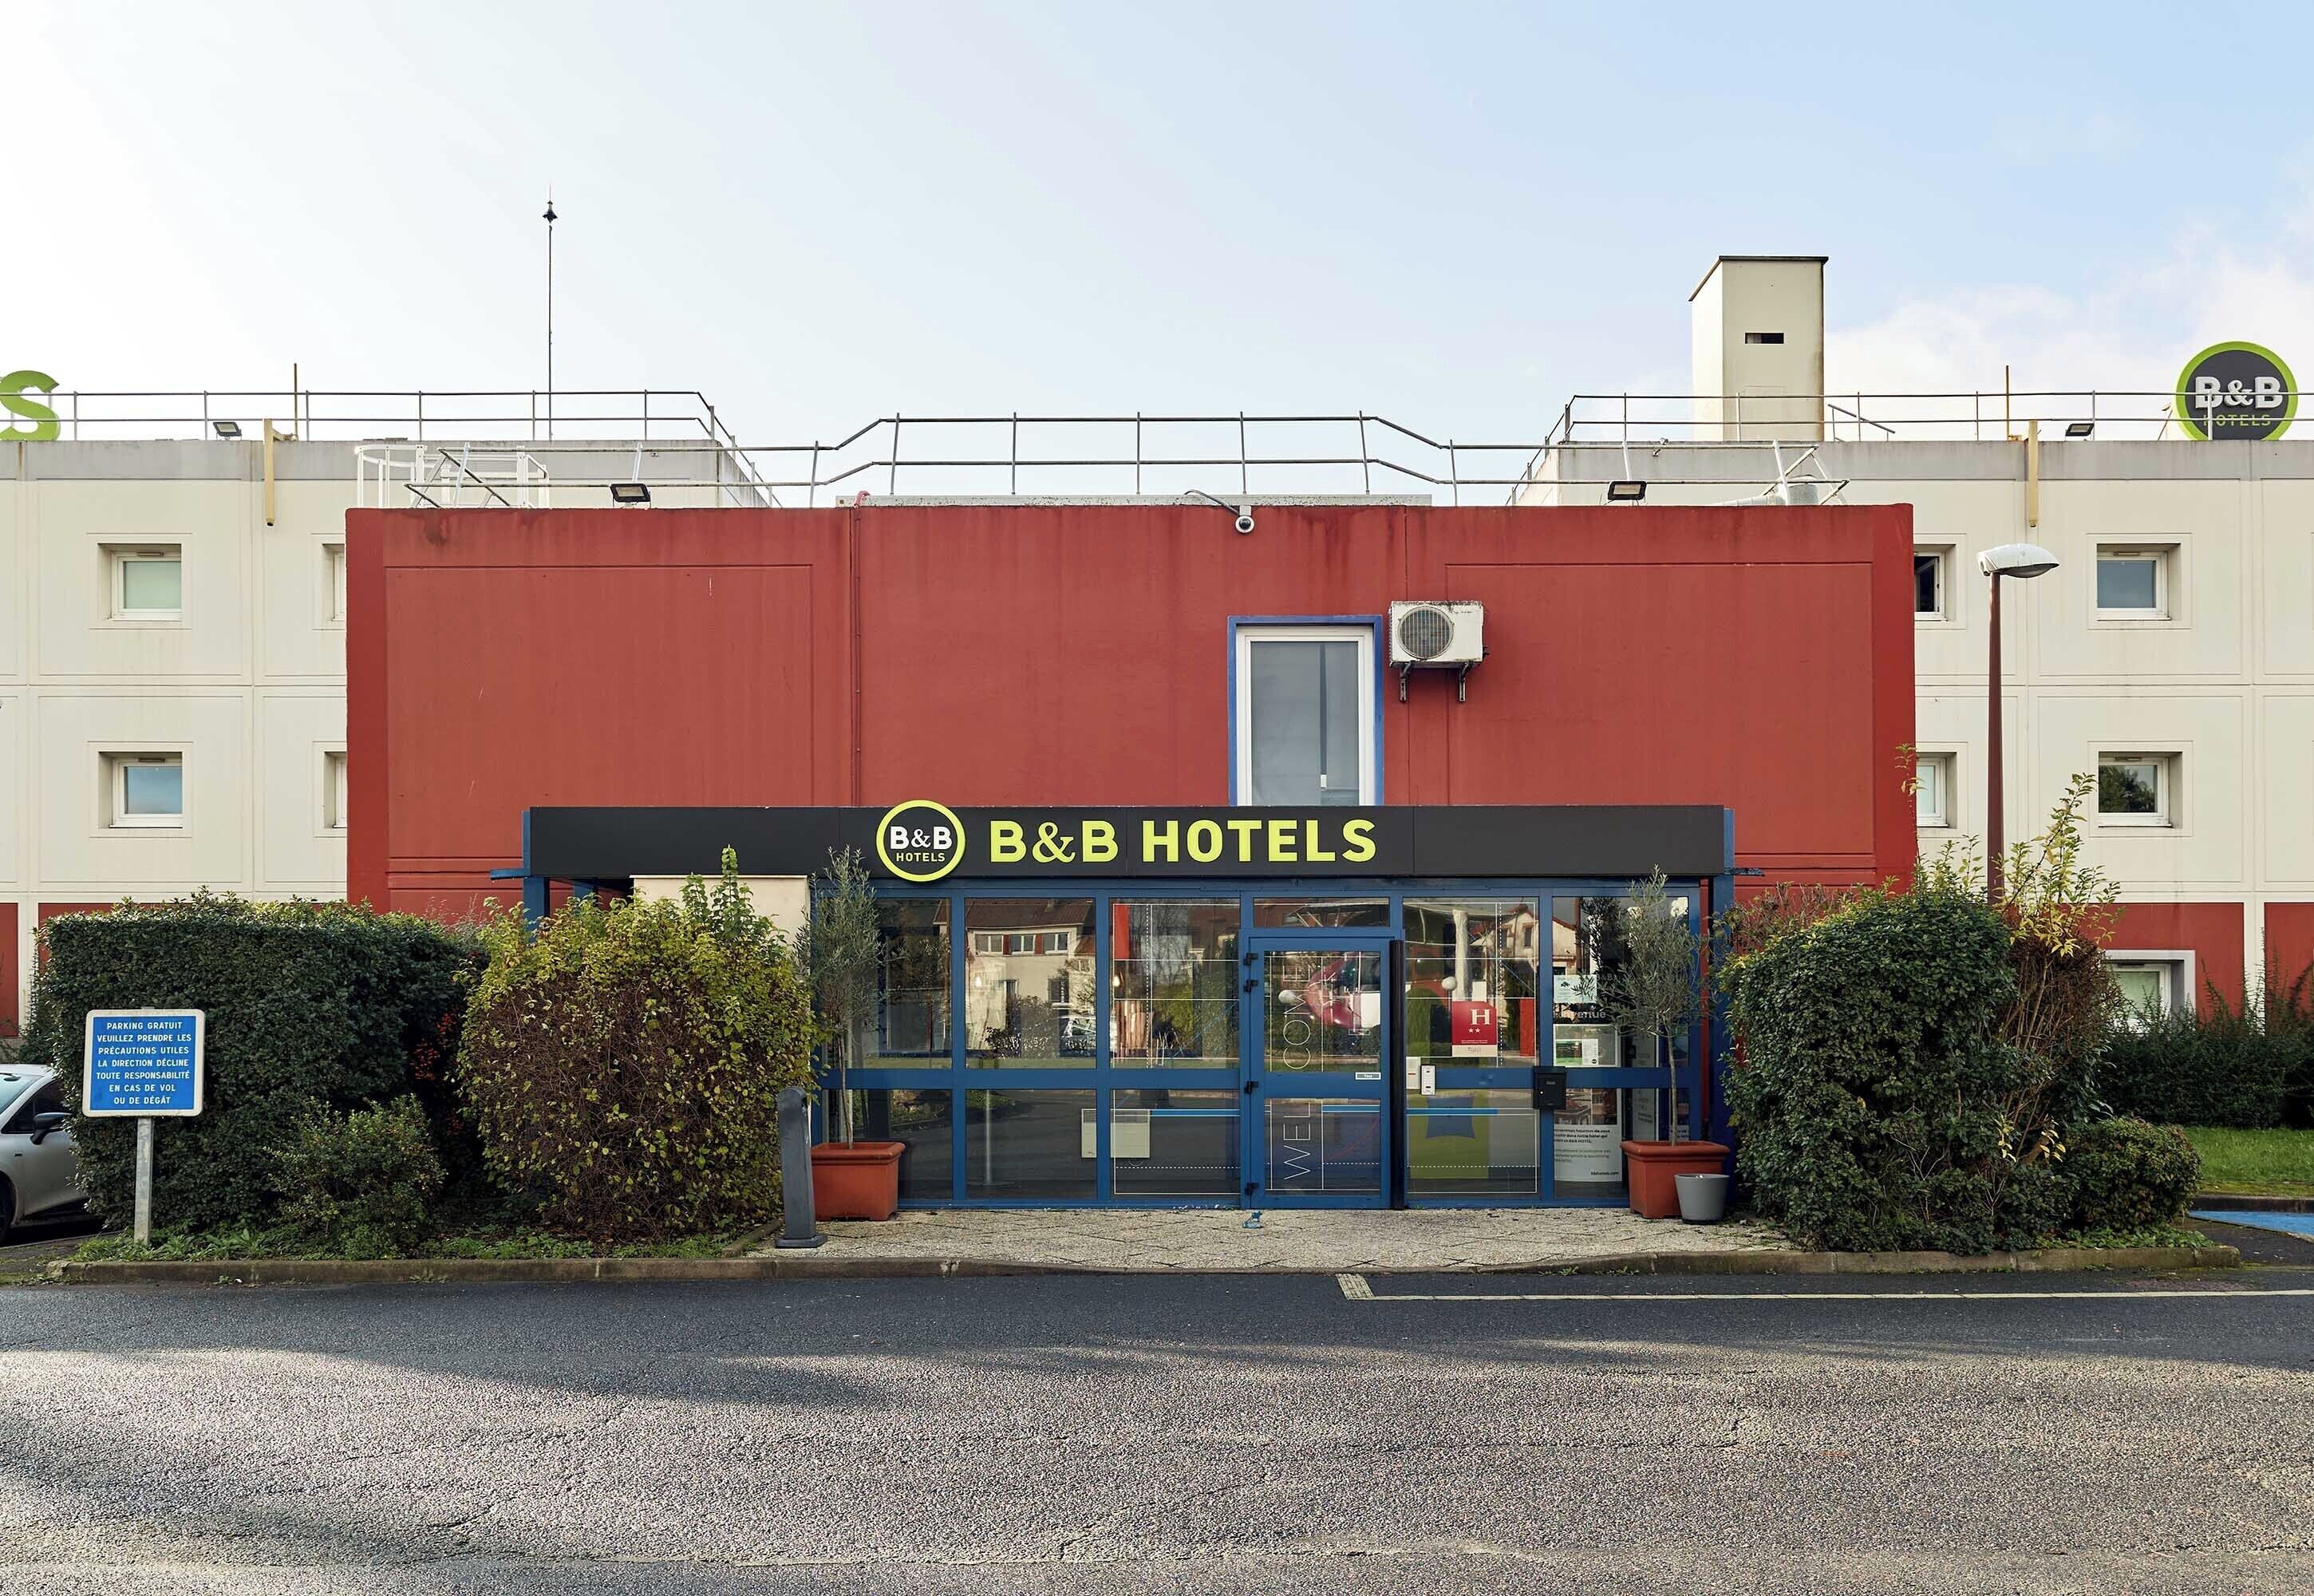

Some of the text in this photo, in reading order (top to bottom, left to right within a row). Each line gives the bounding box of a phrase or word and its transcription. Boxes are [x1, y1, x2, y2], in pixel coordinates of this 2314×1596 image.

[2195, 376, 2284, 409] B&B
[890, 826, 953, 850] B&B
[990, 819, 1376, 863] B&B HOTELS
[896, 852, 946, 862] HOTELS
[1470, 1009, 1491, 1025] H
[156, 1057, 188, 1066] DÉCLINE
[124, 1070, 190, 1079] RESPONSABILITÉ
[144, 1095, 171, 1104] DÉGÂT
